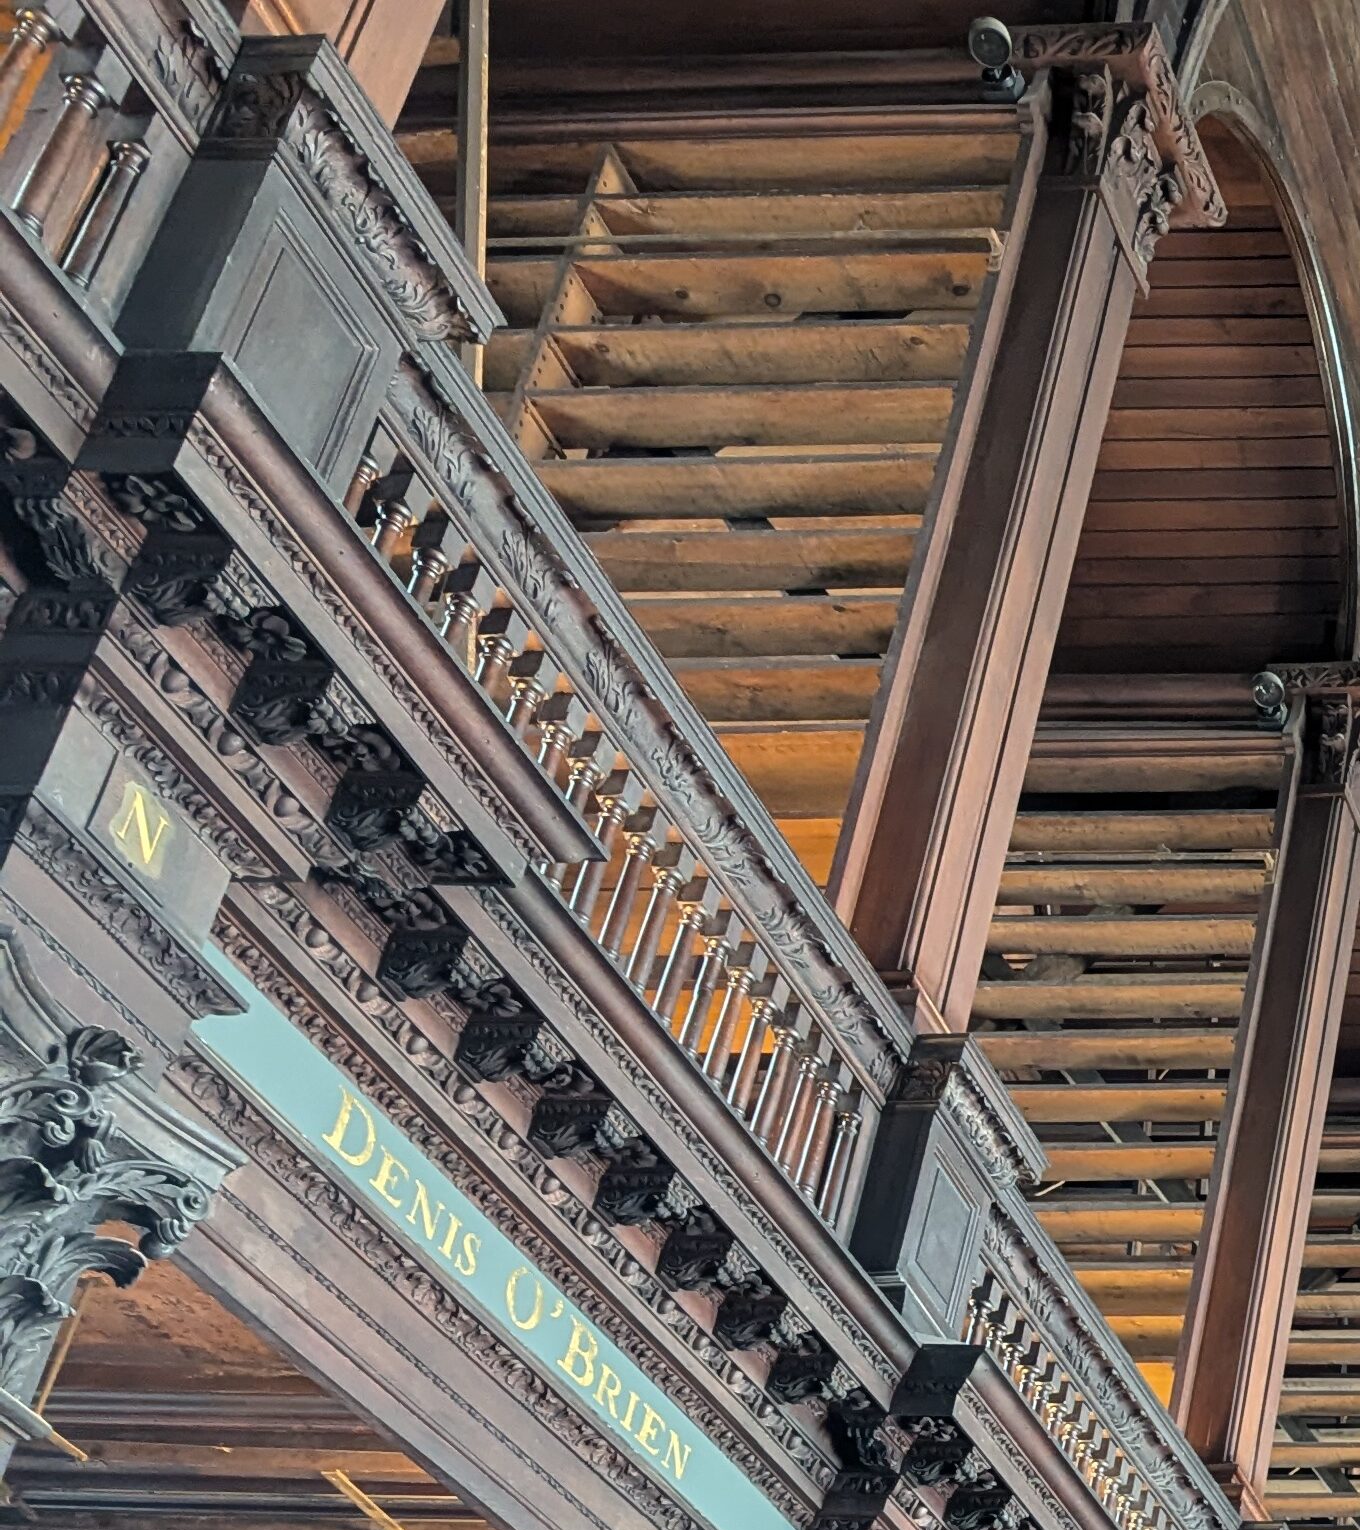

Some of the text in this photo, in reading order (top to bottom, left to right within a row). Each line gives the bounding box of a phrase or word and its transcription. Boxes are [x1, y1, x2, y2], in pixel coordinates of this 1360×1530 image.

[116, 790, 170, 864] N
[322, 1085, 693, 1482] DENIS O'BRIEN
